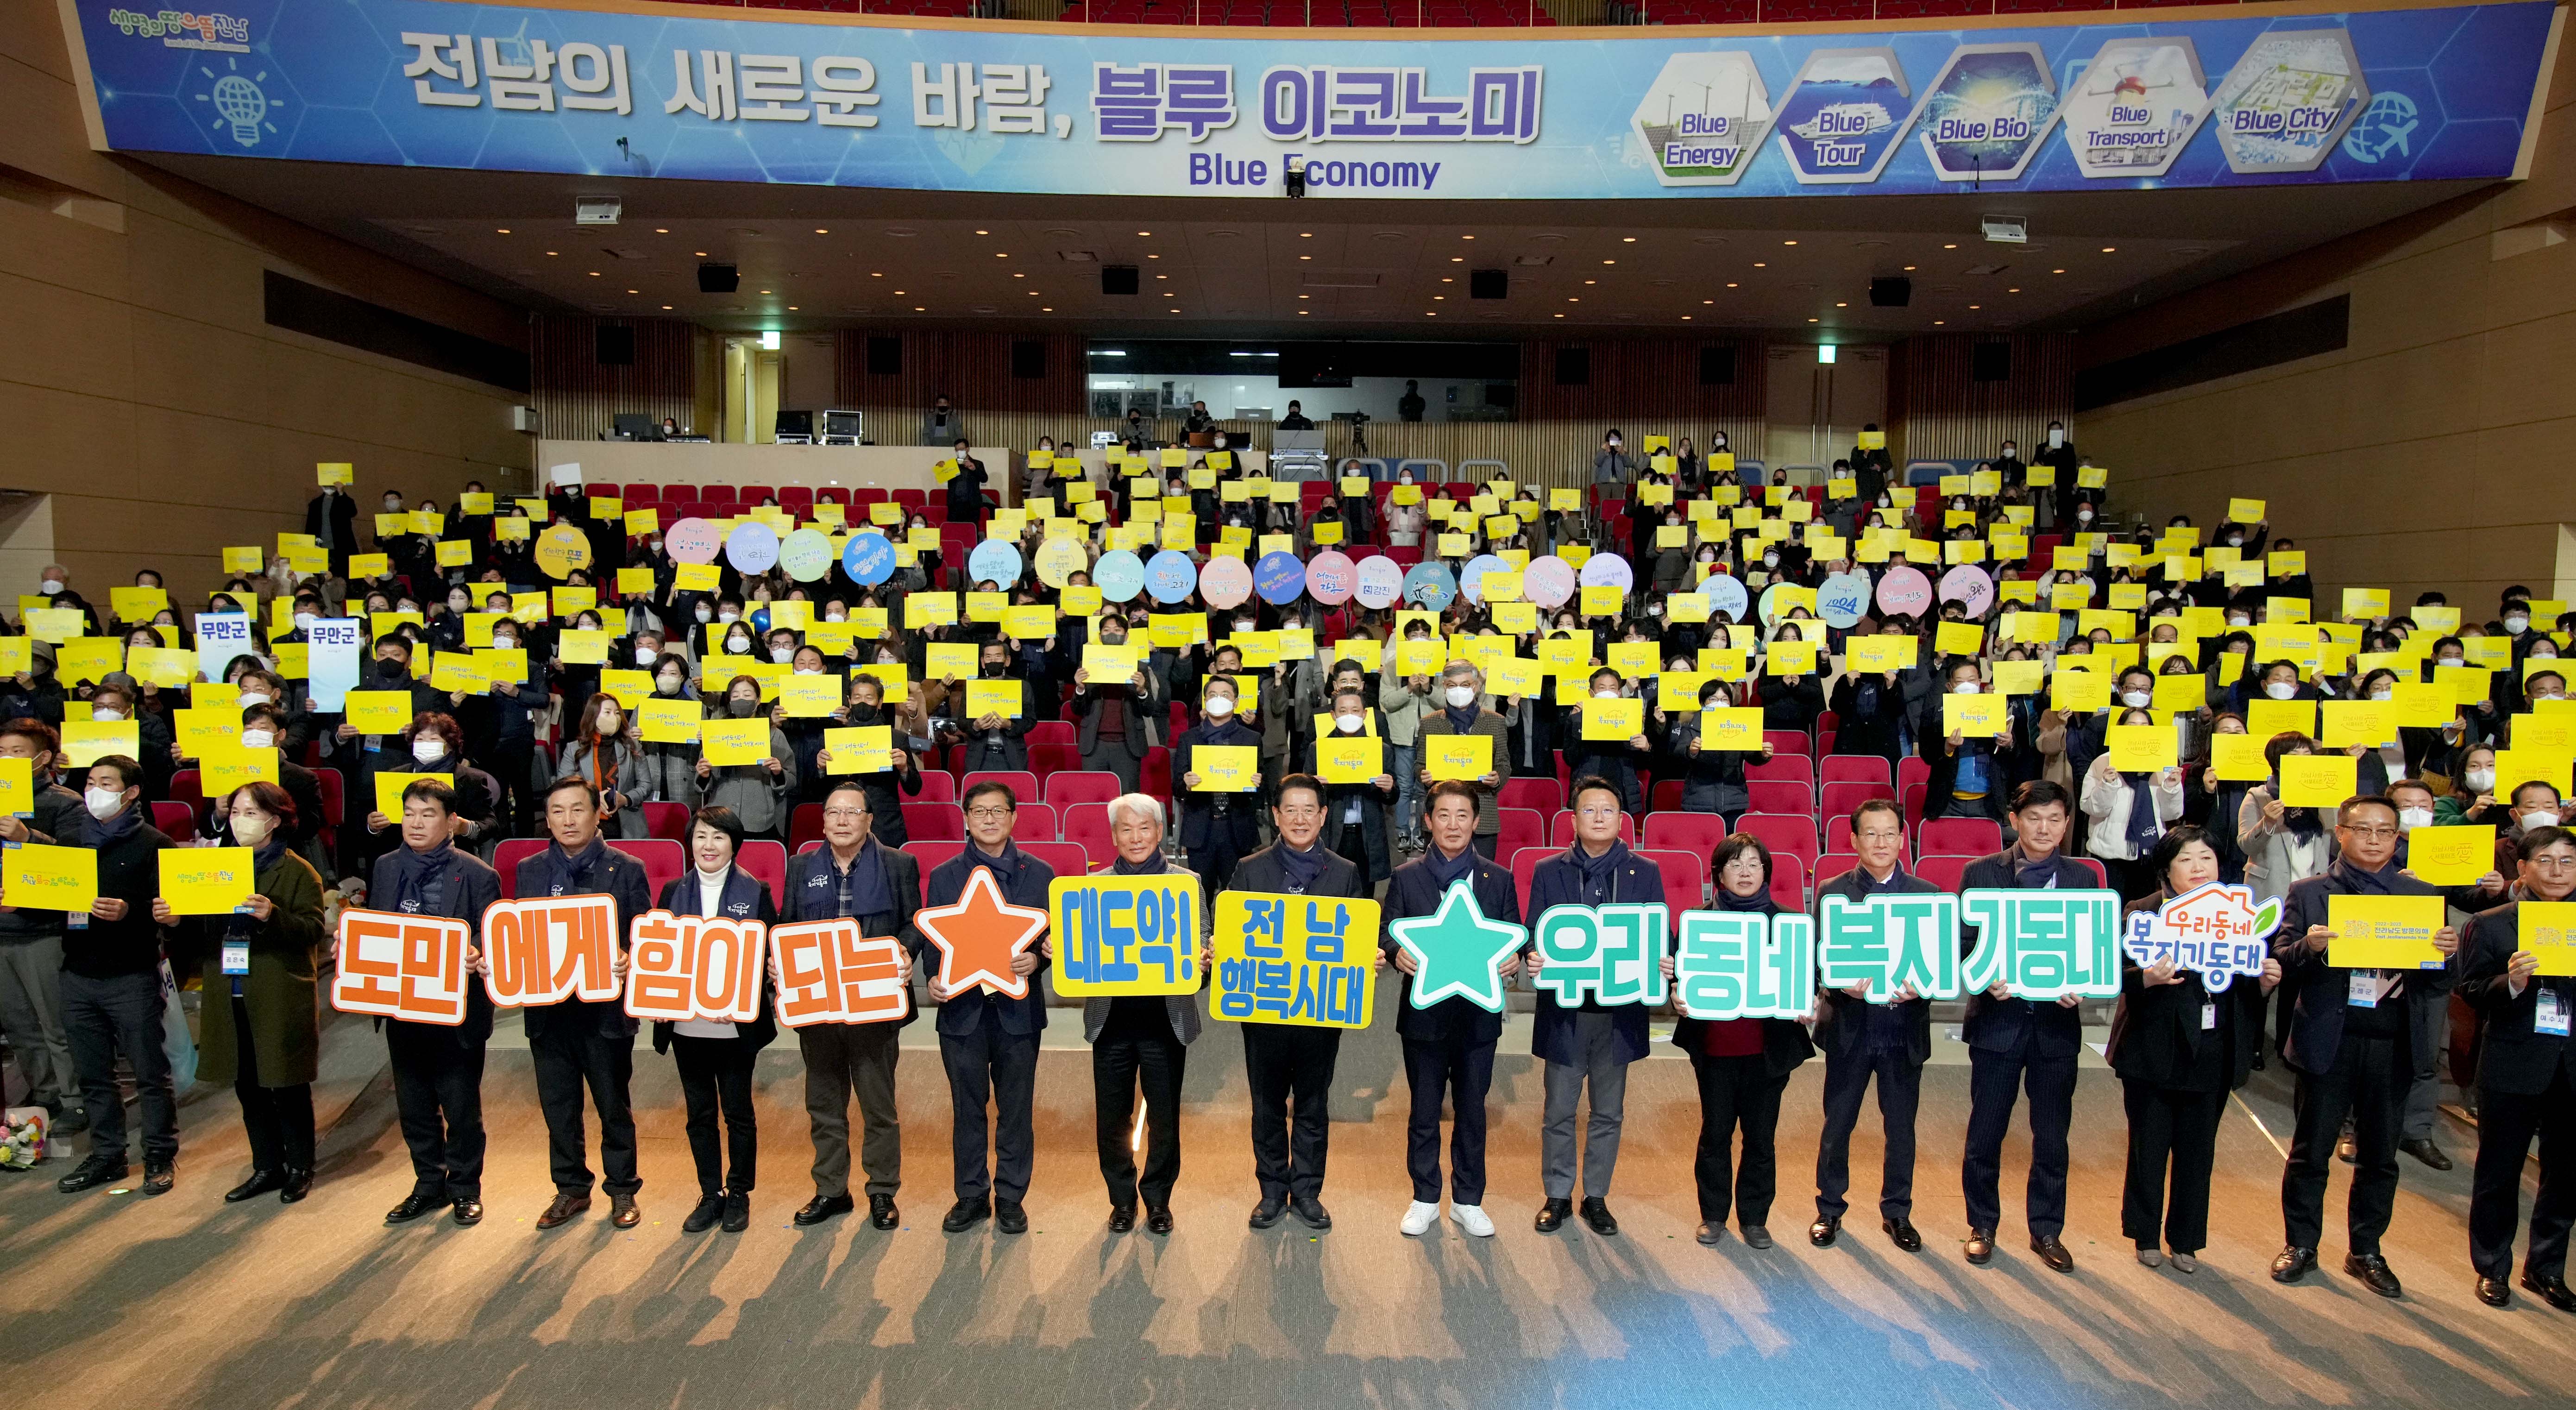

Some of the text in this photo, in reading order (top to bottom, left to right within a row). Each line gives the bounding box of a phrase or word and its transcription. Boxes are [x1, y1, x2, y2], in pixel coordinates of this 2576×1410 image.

[401, 31, 1544, 145] 전남의 새로운 바람, 블루 이코노미
[1682, 113, 1727, 134] Blue
[1819, 112, 1865, 133] Blue
[2111, 106, 2148, 122] Blue
[2235, 108, 2335, 131] Blue City
[1940, 118, 2028, 140] Blue Bio
[2087, 128, 2165, 147] Transport
[1667, 144, 1738, 166] Energy
[1817, 143, 1862, 164] Tour
[1190, 153, 1267, 185] Blue
[201, 621, 246, 640] 무안군
[313, 627, 355, 644] 무안군
[1672, 688, 1698, 700] 복지기동대
[1597, 716, 1626, 728] 복지기동대
[1960, 711, 1988, 725] 복지기동대
[1208, 765, 1238, 779] 복지기동대
[1333, 757, 1363, 770] 복지기동대
[1443, 754, 1472, 768] 복지기동대
[1061, 887, 1193, 984] 대도약!
[2178, 911, 2251, 940] 우리동네
[491, 906, 612, 997] 에게
[1826, 902, 1953, 995] 복지
[1969, 900, 2114, 988] 기동대
[2128, 919, 2260, 986] 복지기동대
[340, 919, 461, 1015] 도민
[633, 919, 758, 1012] 힘이
[1539, 913, 1661, 999] 우리
[1683, 919, 1807, 1011] 동네
[778, 929, 899, 1017] 되는
[1219, 957, 1365, 1024] 행복시대
